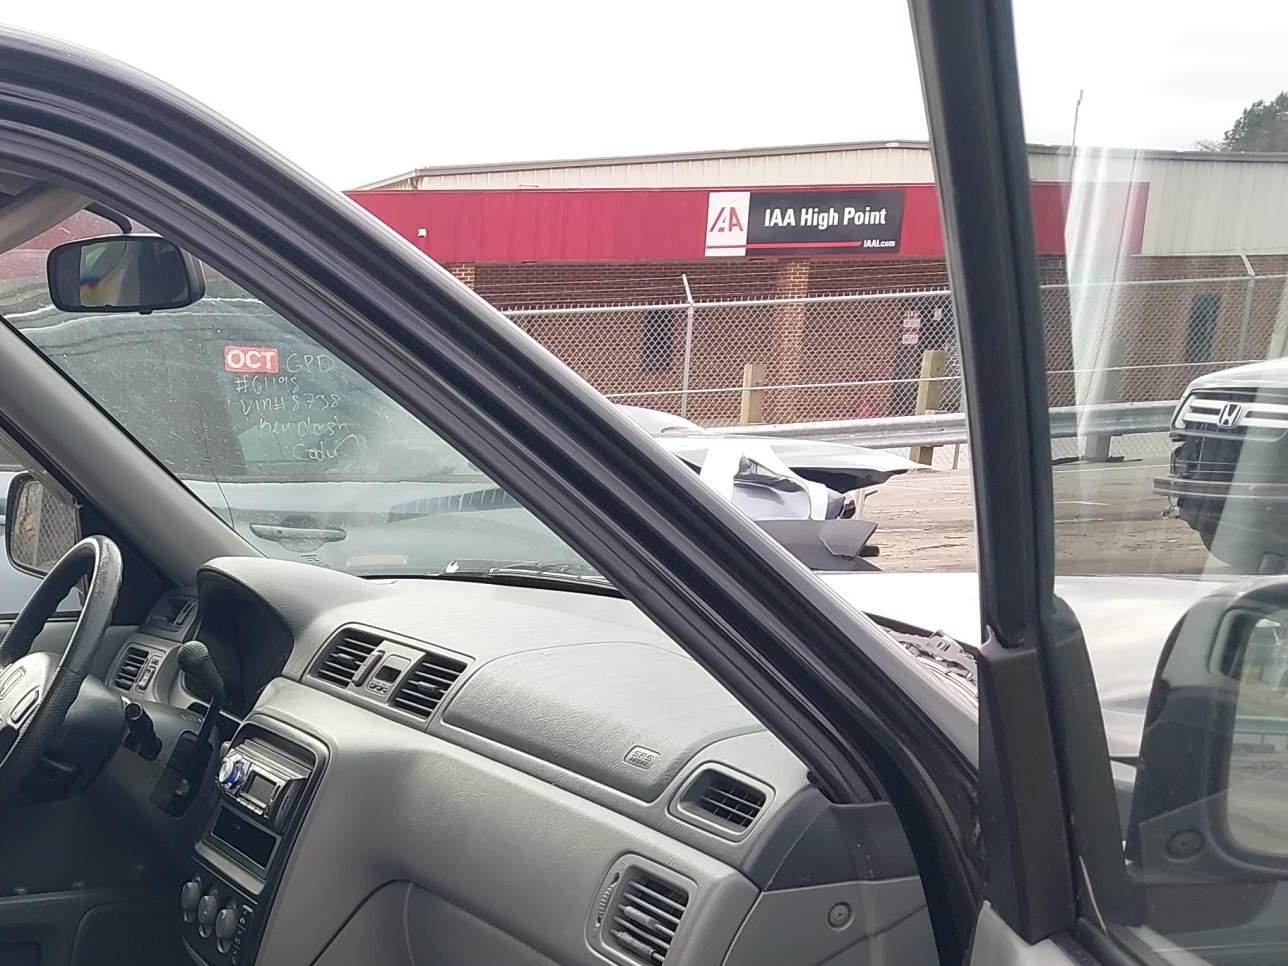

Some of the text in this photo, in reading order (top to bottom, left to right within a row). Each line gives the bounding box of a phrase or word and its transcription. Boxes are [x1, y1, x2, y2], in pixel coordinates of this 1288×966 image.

[764, 206, 887, 230] IAA High Point
[864, 239, 895, 248] IAAI.com
[227, 349, 275, 369] OCT
[286, 353, 336, 373] GPD
